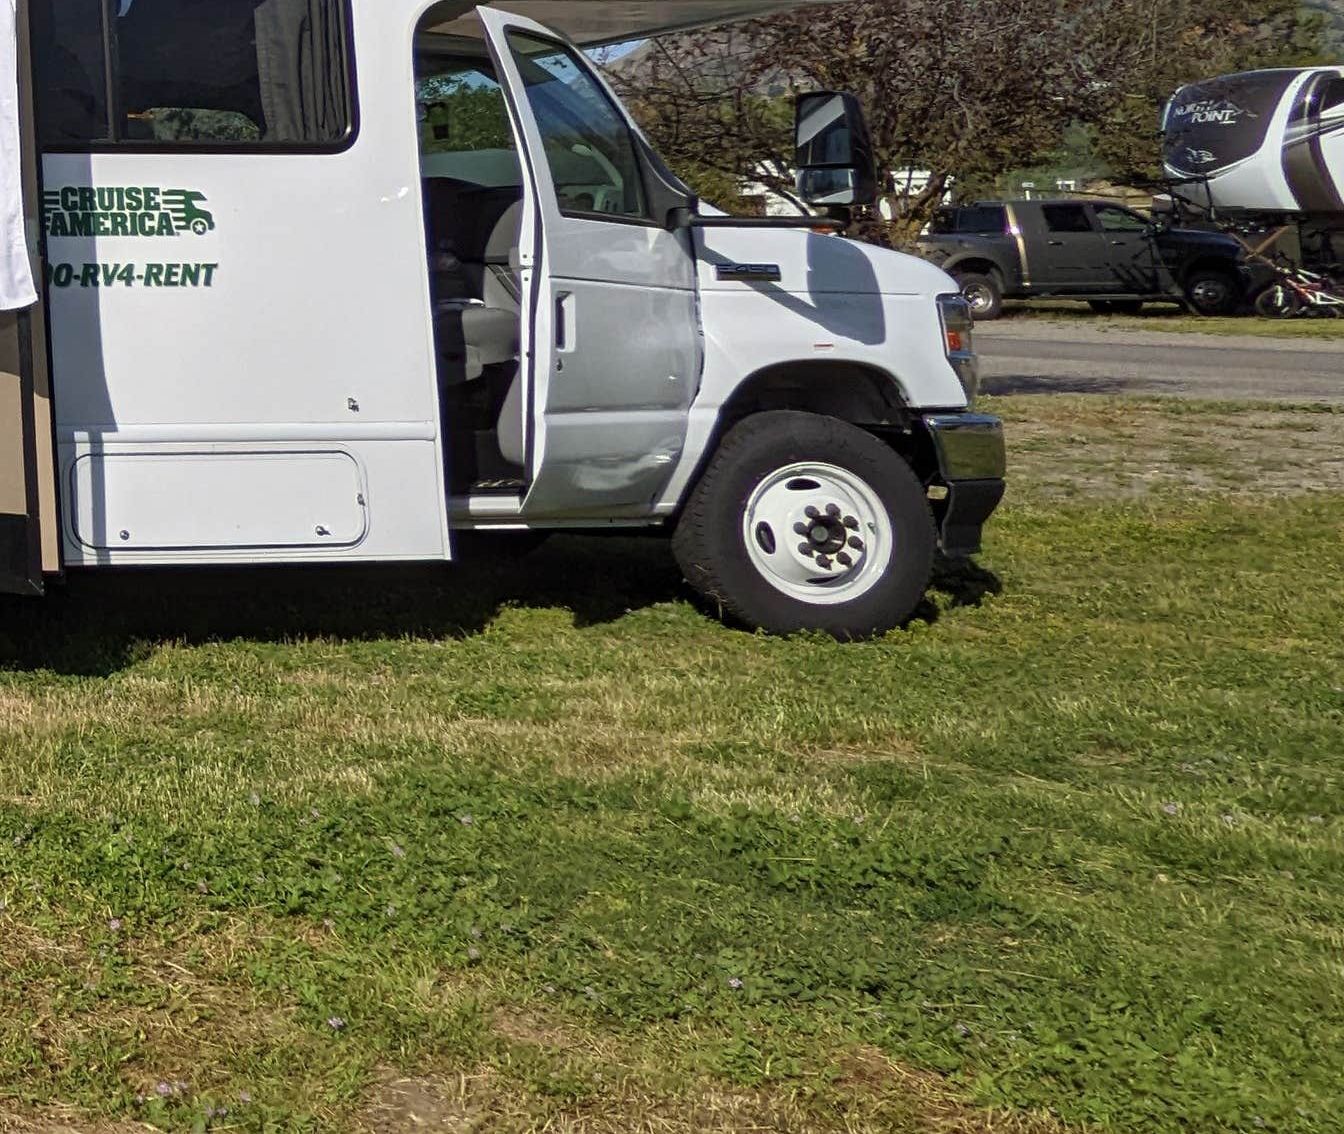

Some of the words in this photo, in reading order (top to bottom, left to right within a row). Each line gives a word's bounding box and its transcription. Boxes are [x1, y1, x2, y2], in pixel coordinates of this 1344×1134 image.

[1192, 109, 1235, 123] POINT
[61, 186, 161, 211] CRUISE
[50, 212, 175, 236] AMERICA
